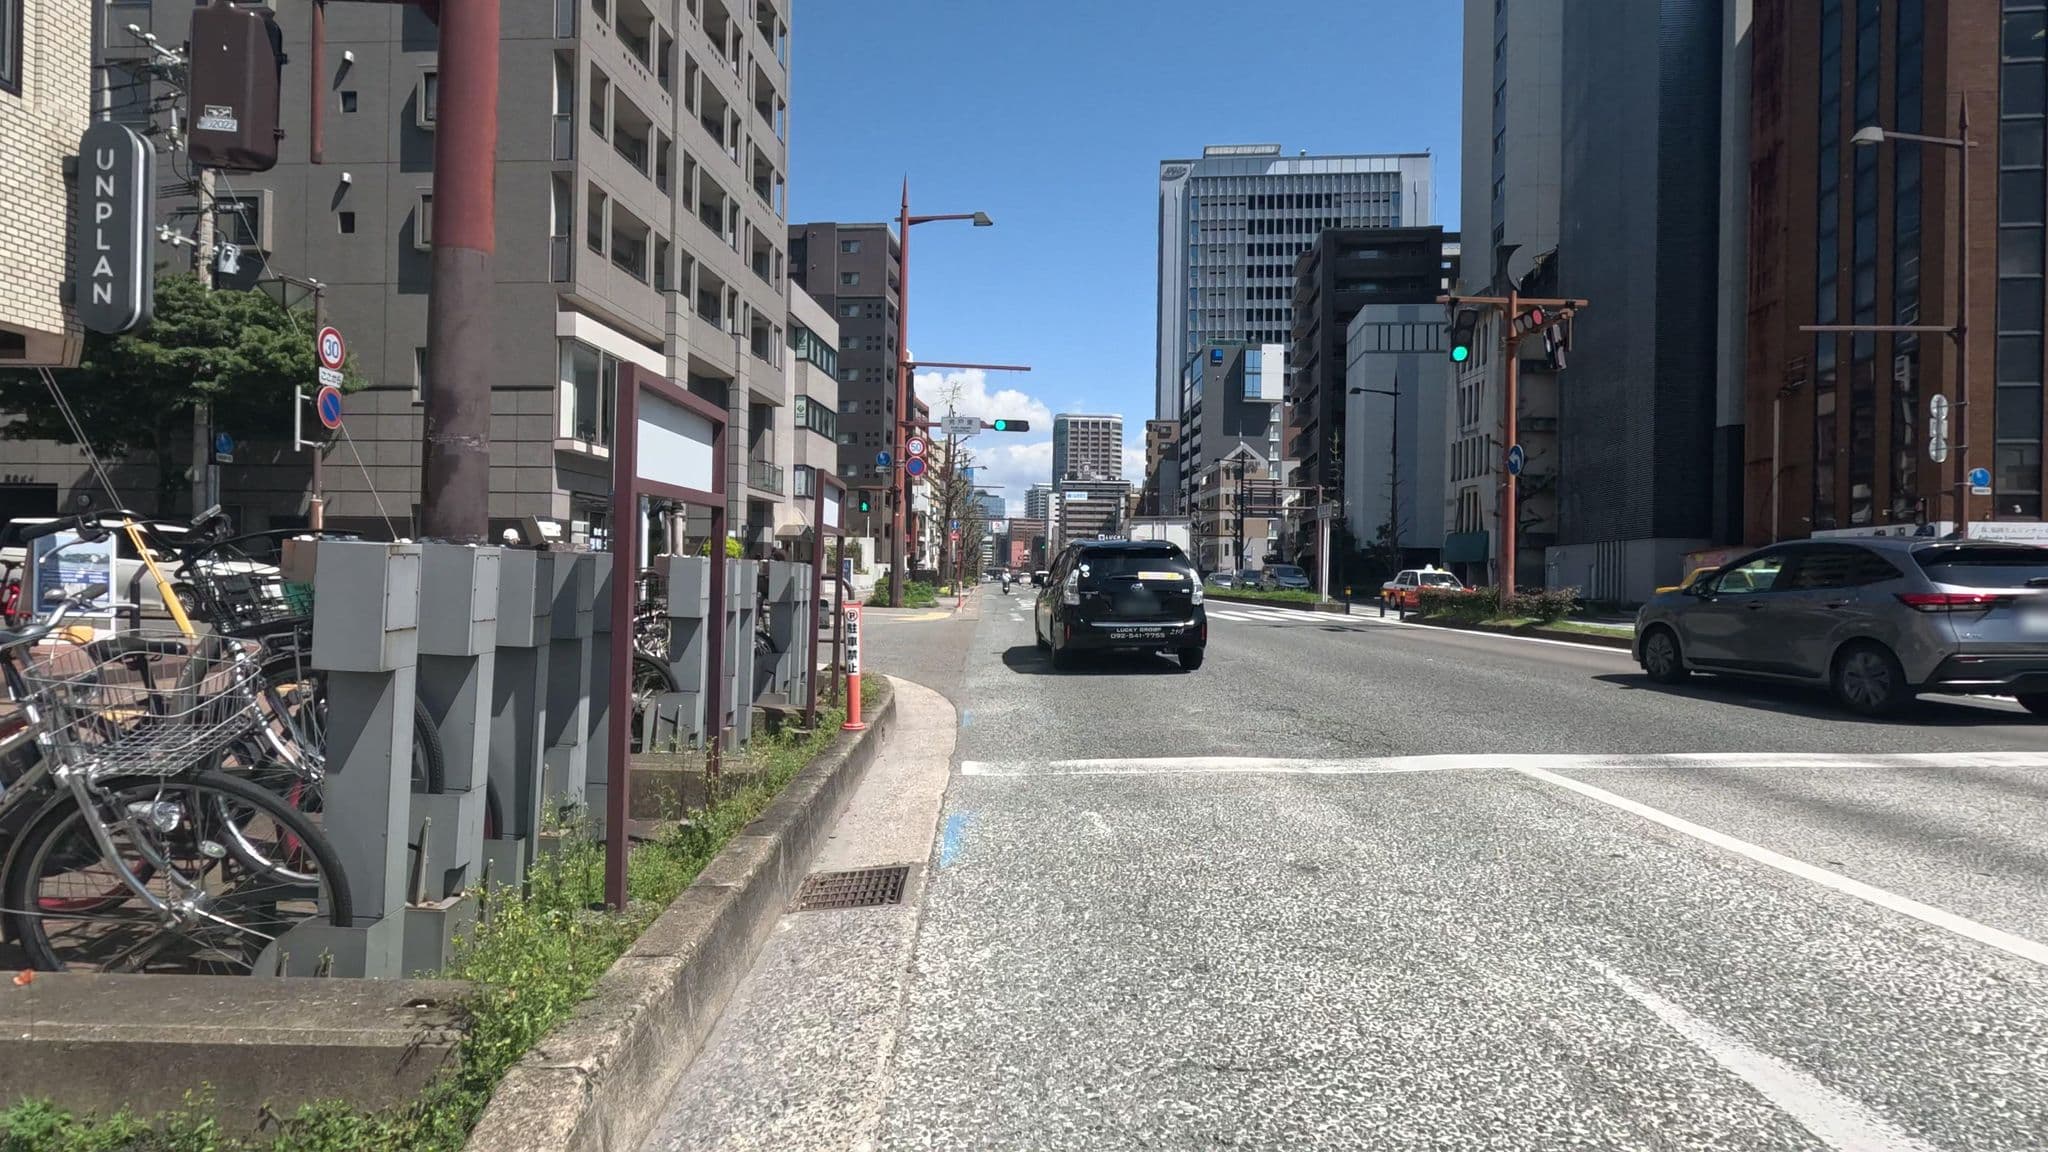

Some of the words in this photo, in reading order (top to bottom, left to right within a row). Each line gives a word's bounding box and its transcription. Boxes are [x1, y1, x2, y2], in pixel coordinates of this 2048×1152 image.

[92, 148, 115, 305] UNPLAN
[325, 339, 339, 359] 30
[911, 442, 922, 451] 50
[847, 623, 858, 673] 駐車禁止
